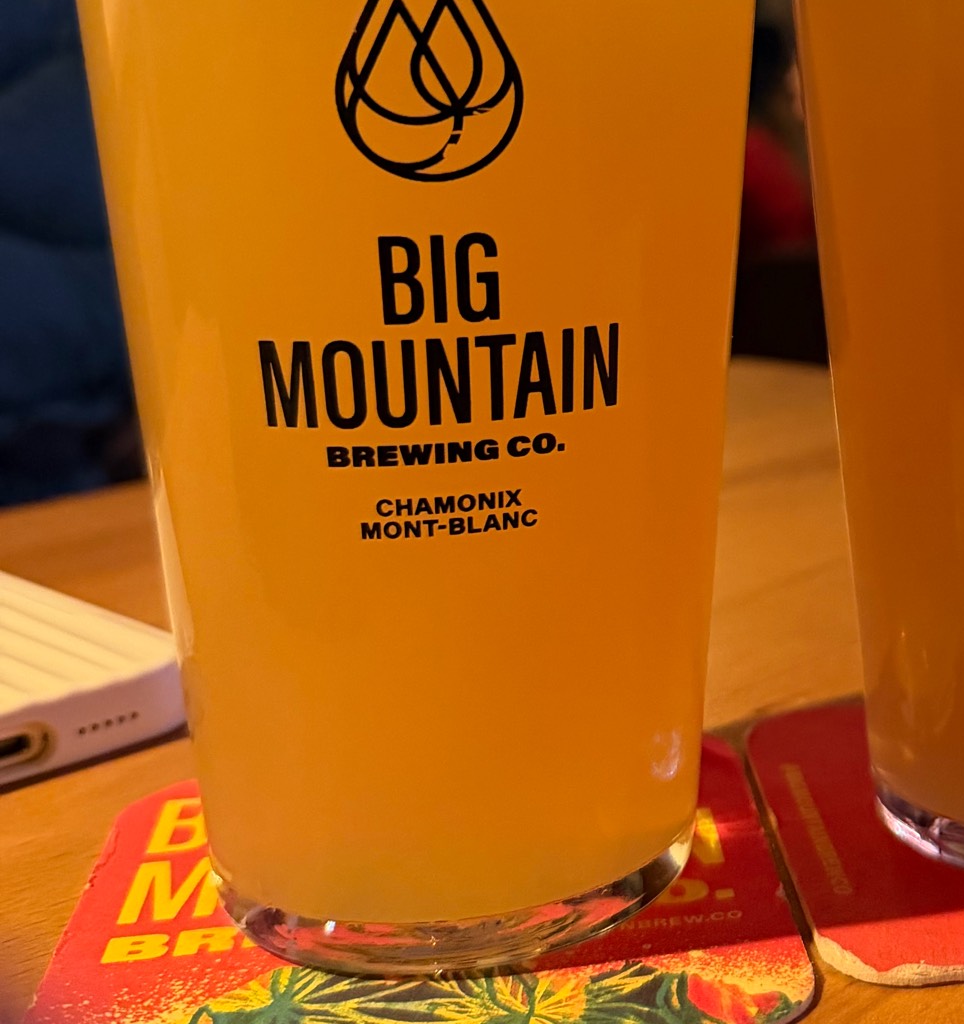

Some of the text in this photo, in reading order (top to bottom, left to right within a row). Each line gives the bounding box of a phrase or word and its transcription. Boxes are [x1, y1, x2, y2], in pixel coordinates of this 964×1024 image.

[377, 232, 501, 326] BIG
[258, 322, 619, 430] MOUNTAIN
[326, 432, 566, 468] BREWING CO.
[376, 489, 523, 518] CHAMONIX
[361, 509, 539, 540] MONT-BLANC
